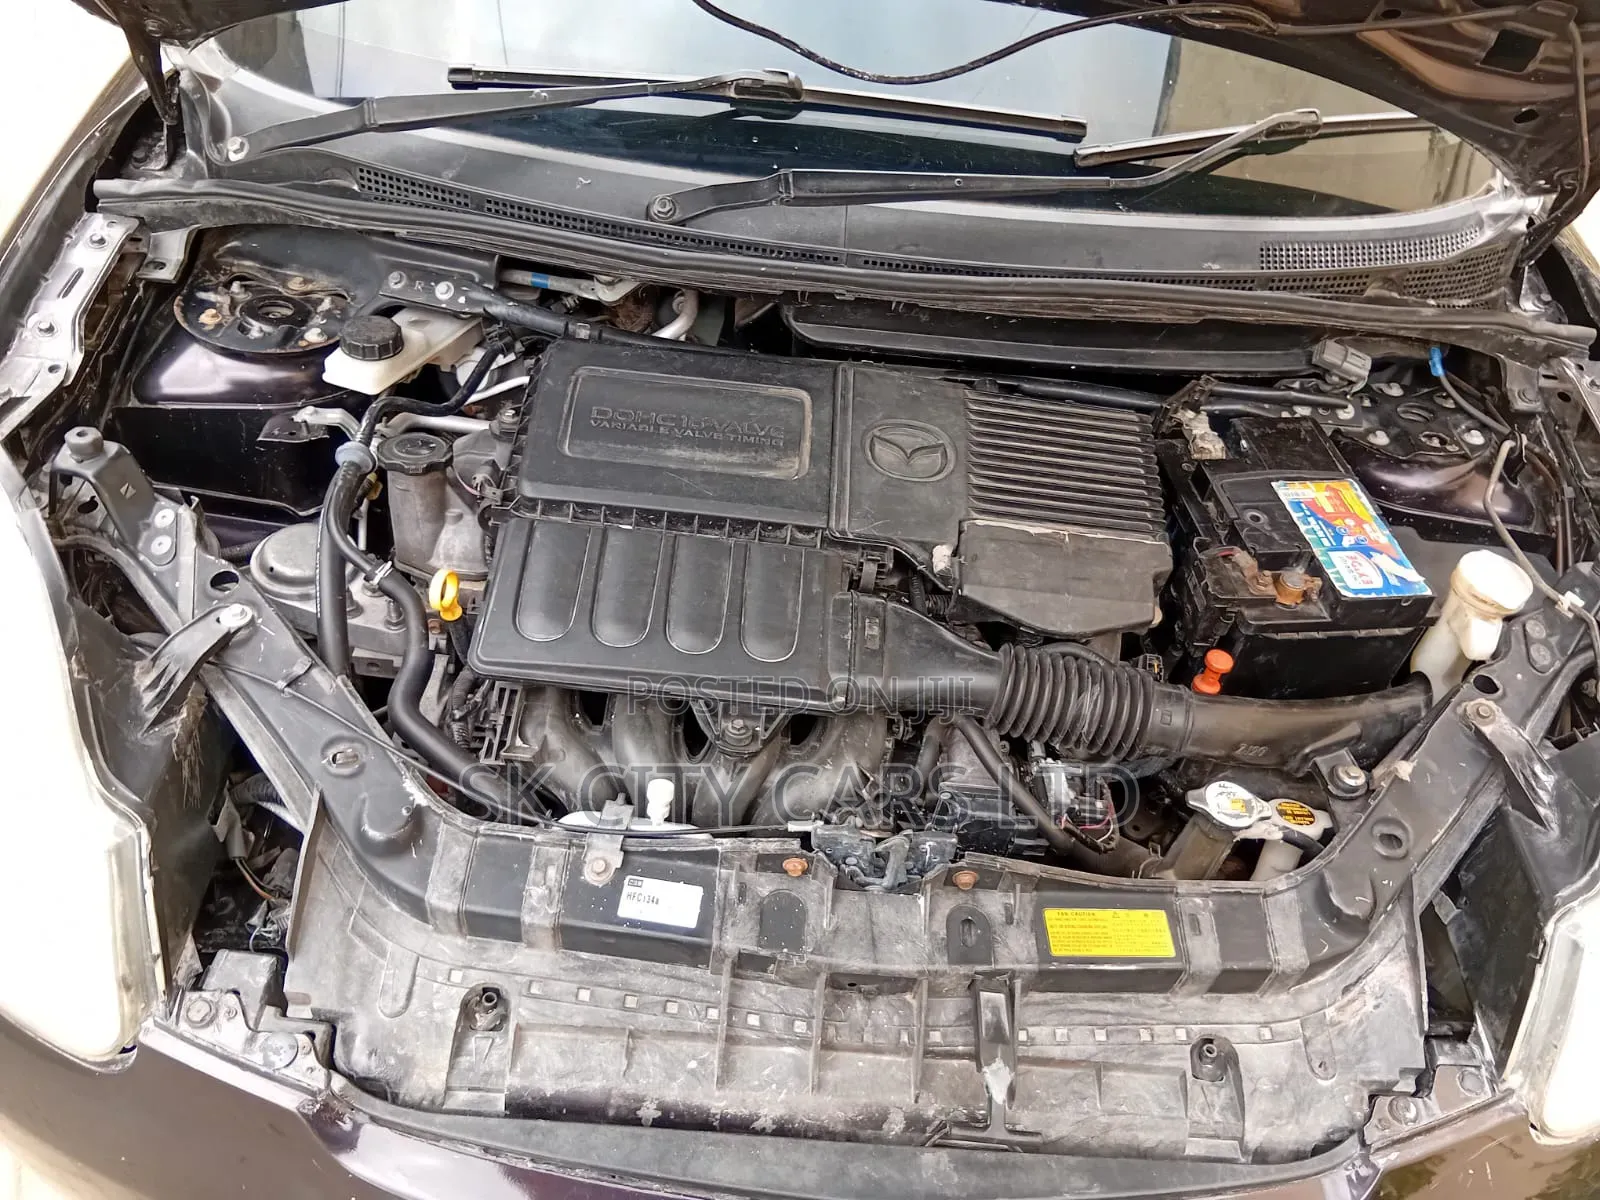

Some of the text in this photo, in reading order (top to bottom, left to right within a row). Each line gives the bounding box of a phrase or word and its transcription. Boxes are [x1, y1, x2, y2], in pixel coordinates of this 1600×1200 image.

[591, 406, 677, 426] DOHC
[589, 419, 785, 448] VARIABLE VALVE TIMING
